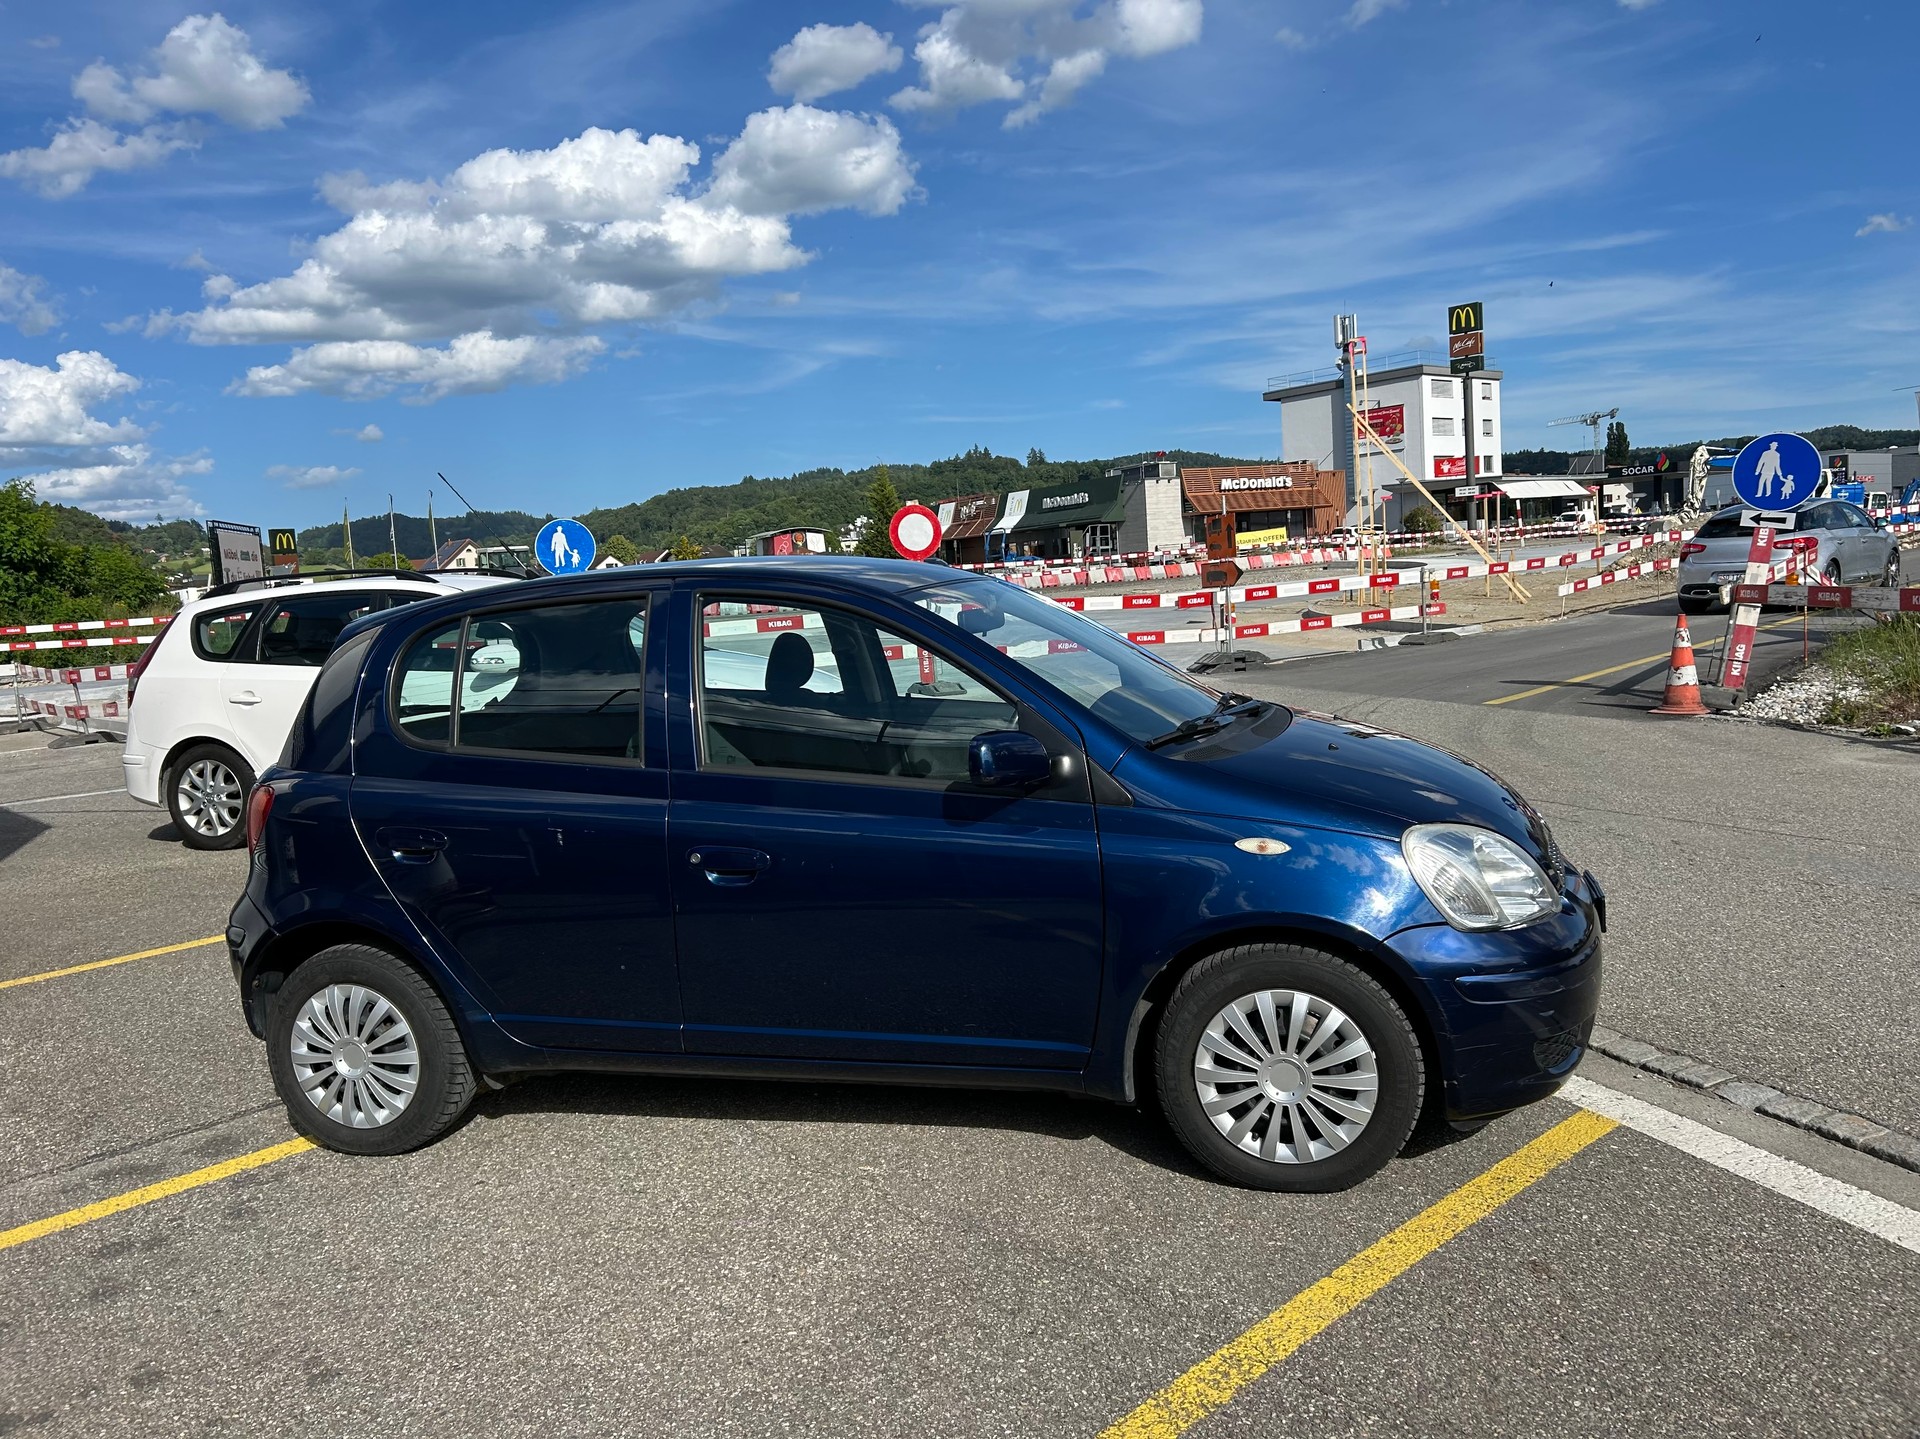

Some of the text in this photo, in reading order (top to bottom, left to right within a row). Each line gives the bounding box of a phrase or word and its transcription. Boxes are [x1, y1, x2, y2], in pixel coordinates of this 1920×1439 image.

[1622, 466, 1654, 475] SOCAR
[1221, 475, 1293, 490] McDonald's
[1042, 491, 1089, 509] McDonald's
[1263, 534, 1285, 542] OFFEN
[1376, 576, 1393, 584] KIBAG
[1315, 582, 1333, 590] KIBAG
[1252, 589, 1270, 597] KIBAG
[1740, 590, 1841, 601] KIBAG KIBAG
[1188, 596, 1205, 604] KIBAG
[1368, 612, 1384, 620] KIBAG
[768, 619, 793, 628] KIBAG
[1308, 619, 1325, 627] KIBAG
[1243, 627, 1261, 635] KIBAG
[1137, 634, 1156, 642] KIBAG
